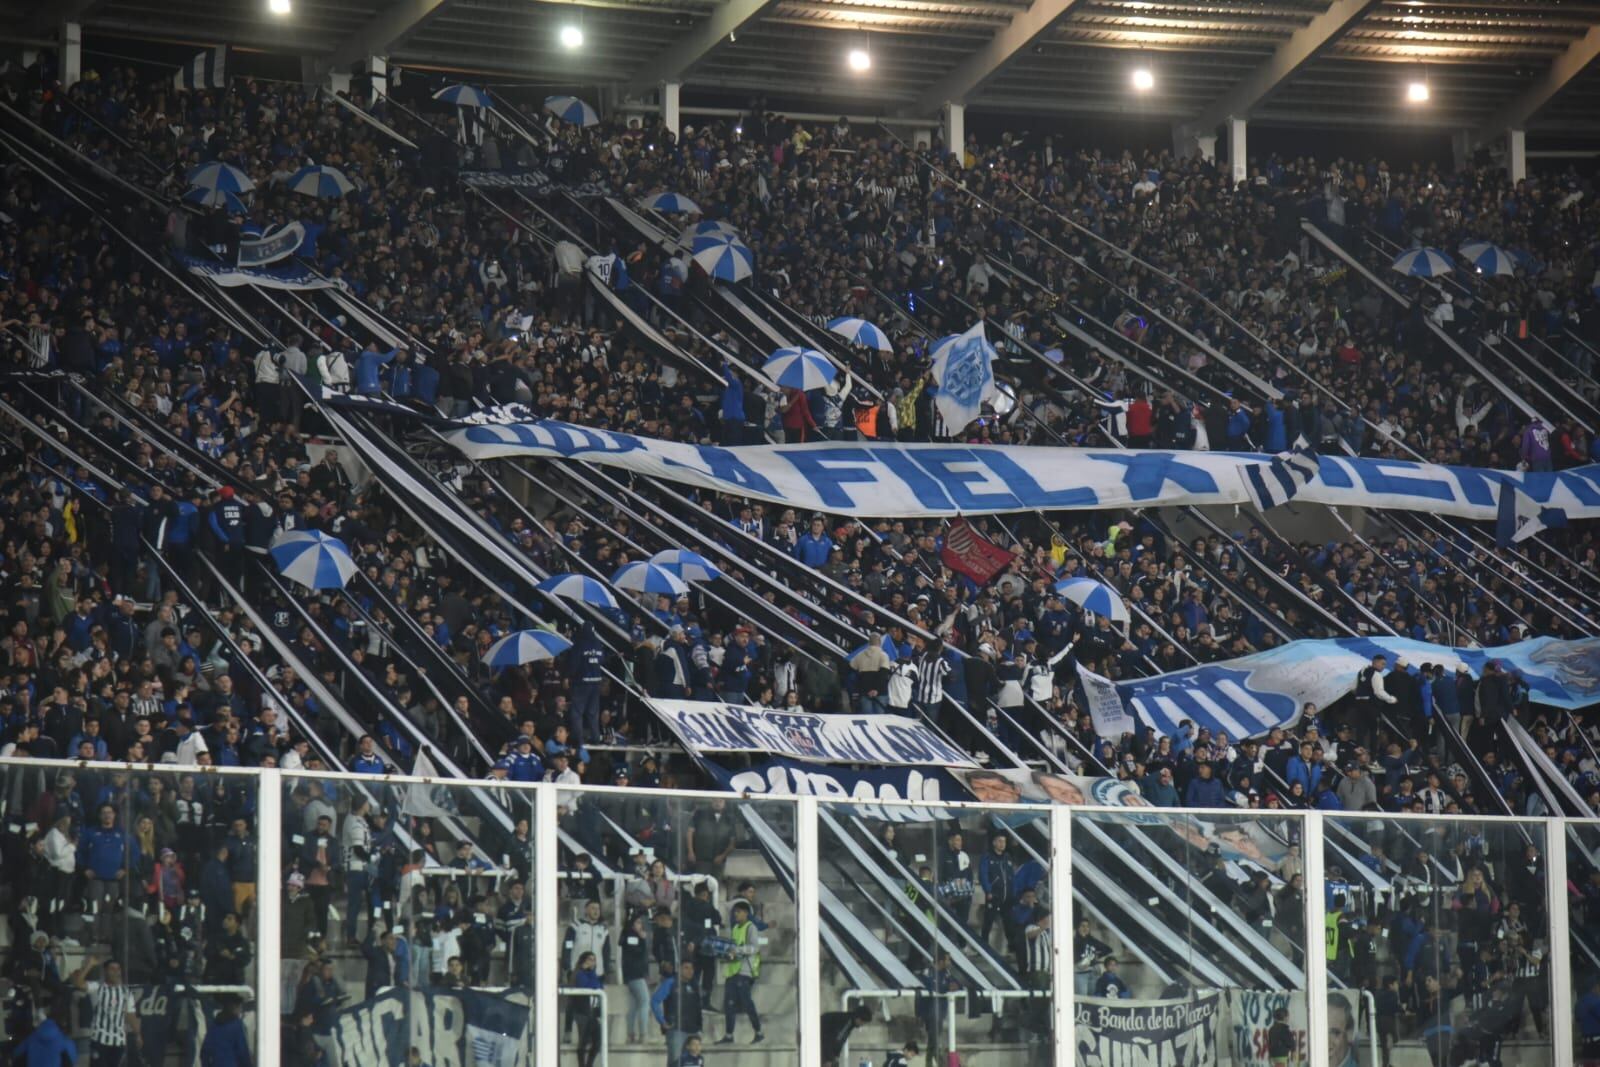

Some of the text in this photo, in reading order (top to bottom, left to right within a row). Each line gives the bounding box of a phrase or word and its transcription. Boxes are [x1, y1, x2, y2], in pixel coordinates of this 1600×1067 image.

[661, 444, 788, 499] A
[773, 449, 1098, 509] FIEL
[1098, 1006, 1146, 1032] Banda
[1173, 1002, 1211, 1030] Plaza
